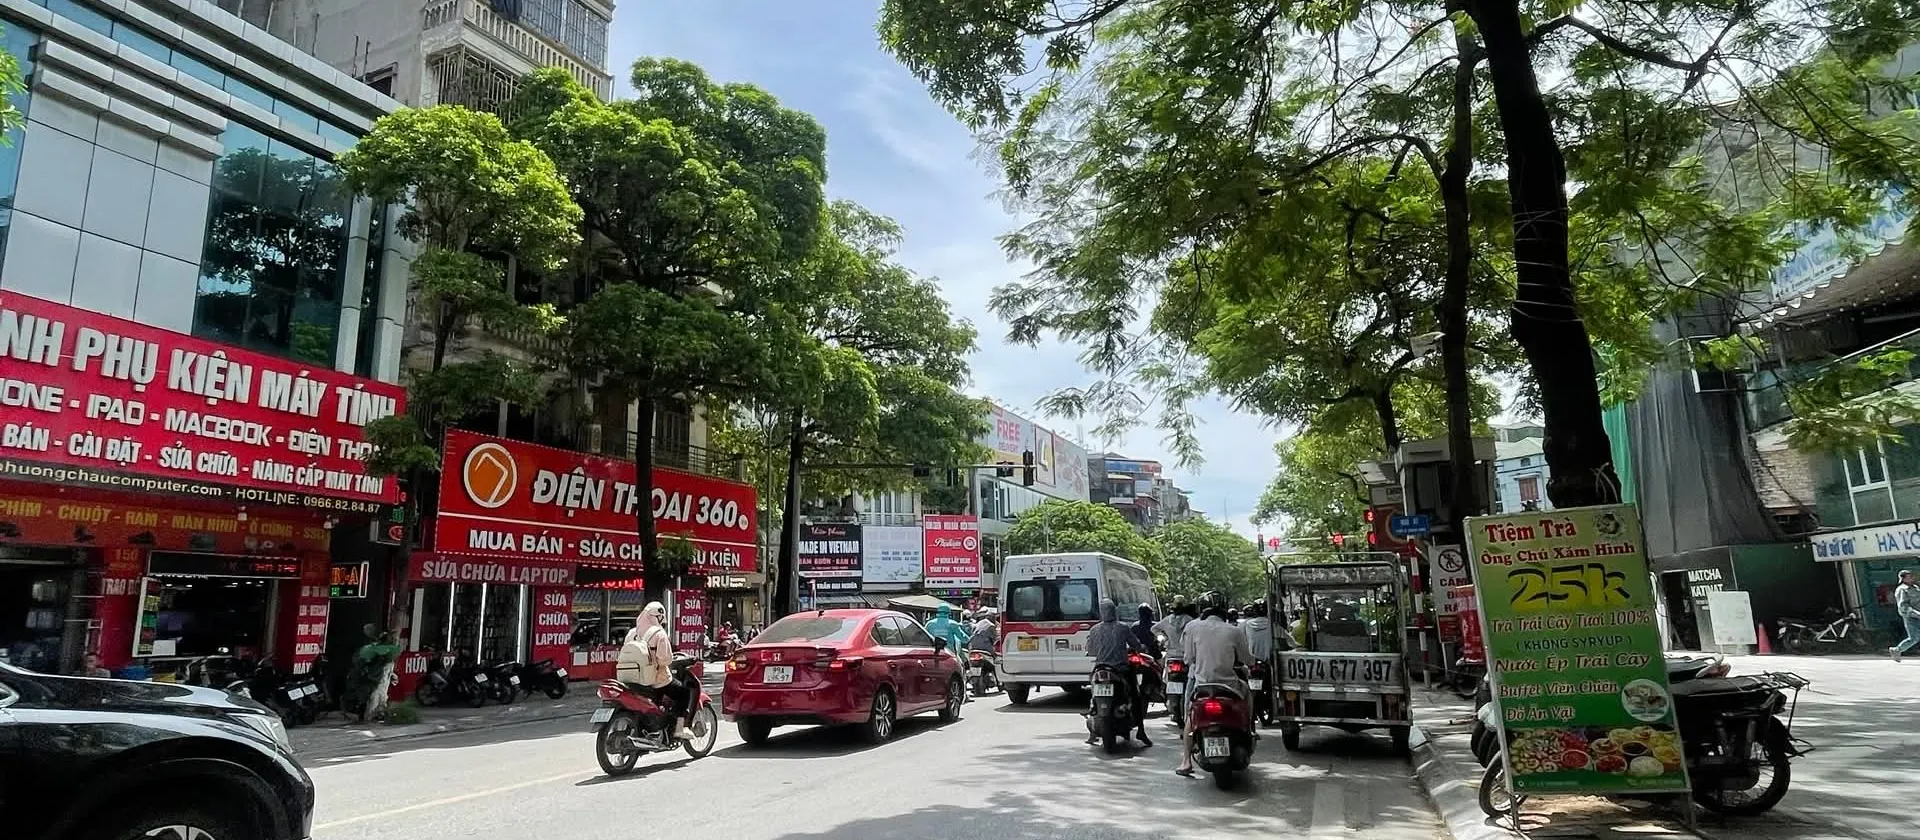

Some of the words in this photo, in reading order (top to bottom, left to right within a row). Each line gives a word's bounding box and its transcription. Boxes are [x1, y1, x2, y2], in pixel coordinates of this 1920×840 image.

[74, 327, 159, 392] PHỤ
[168, 348, 253, 406] KIỆN
[258, 370, 327, 417] MÁY
[336, 383, 396, 427] TÍNH
[86, 394, 145, 426] IPAD
[164, 408, 272, 447] MACBOOK
[288, 428, 331, 457] ĐIỆN
[2, 421, 49, 451] BÁN
[69, 430, 102, 459] CÀI
[105, 436, 142, 466] ĐẶT
[159, 441, 193, 471] SỬA
[197, 450, 238, 477] CHỮA
[252, 458, 294, 485] NÂNG
[295, 462, 324, 487] CẤP
[325, 469, 353, 491] MÁY
[236, 488, 300, 506] HOTLINE:
[533, 466, 604, 518] ĐIỆN
[695, 496, 737, 528] 360
[58, 504, 112, 525] CHUỘT
[126, 510, 159, 527] RAM
[1485, 522, 1535, 546] Tiệm
[1539, 516, 1577, 538] Trà
[469, 529, 516, 551] MUA
[522, 530, 563, 554] BÁN
[579, 533, 615, 559] SỬA
[710, 548, 740, 571] KIỆN
[1481, 550, 1512, 566] Ông
[1517, 548, 1548, 562] Chú
[1553, 546, 1590, 559] Xăm
[1594, 543, 1635, 556] Hình
[422, 556, 457, 579] SỬA
[461, 561, 506, 581] CHỮA
[510, 567, 569, 584] LAPTOP
[1688, 568, 1722, 582] MATCHA
[544, 590, 566, 606] SỬA
[539, 612, 569, 626] CHỮA
[1517, 616, 1542, 631] Trái
[1547, 613, 1573, 631] Cây
[1610, 609, 1650, 627] 100%
[535, 633, 570, 646] LAPTOP
[1287, 657, 1325, 681] 0974
[1329, 658, 1356, 681] 677
[1363, 659, 1392, 682] 397
[1496, 658, 1538, 672] Nước
[1575, 653, 1609, 669] Trái
[1615, 652, 1650, 668] Cây
[1500, 683, 1541, 699] Buffet
